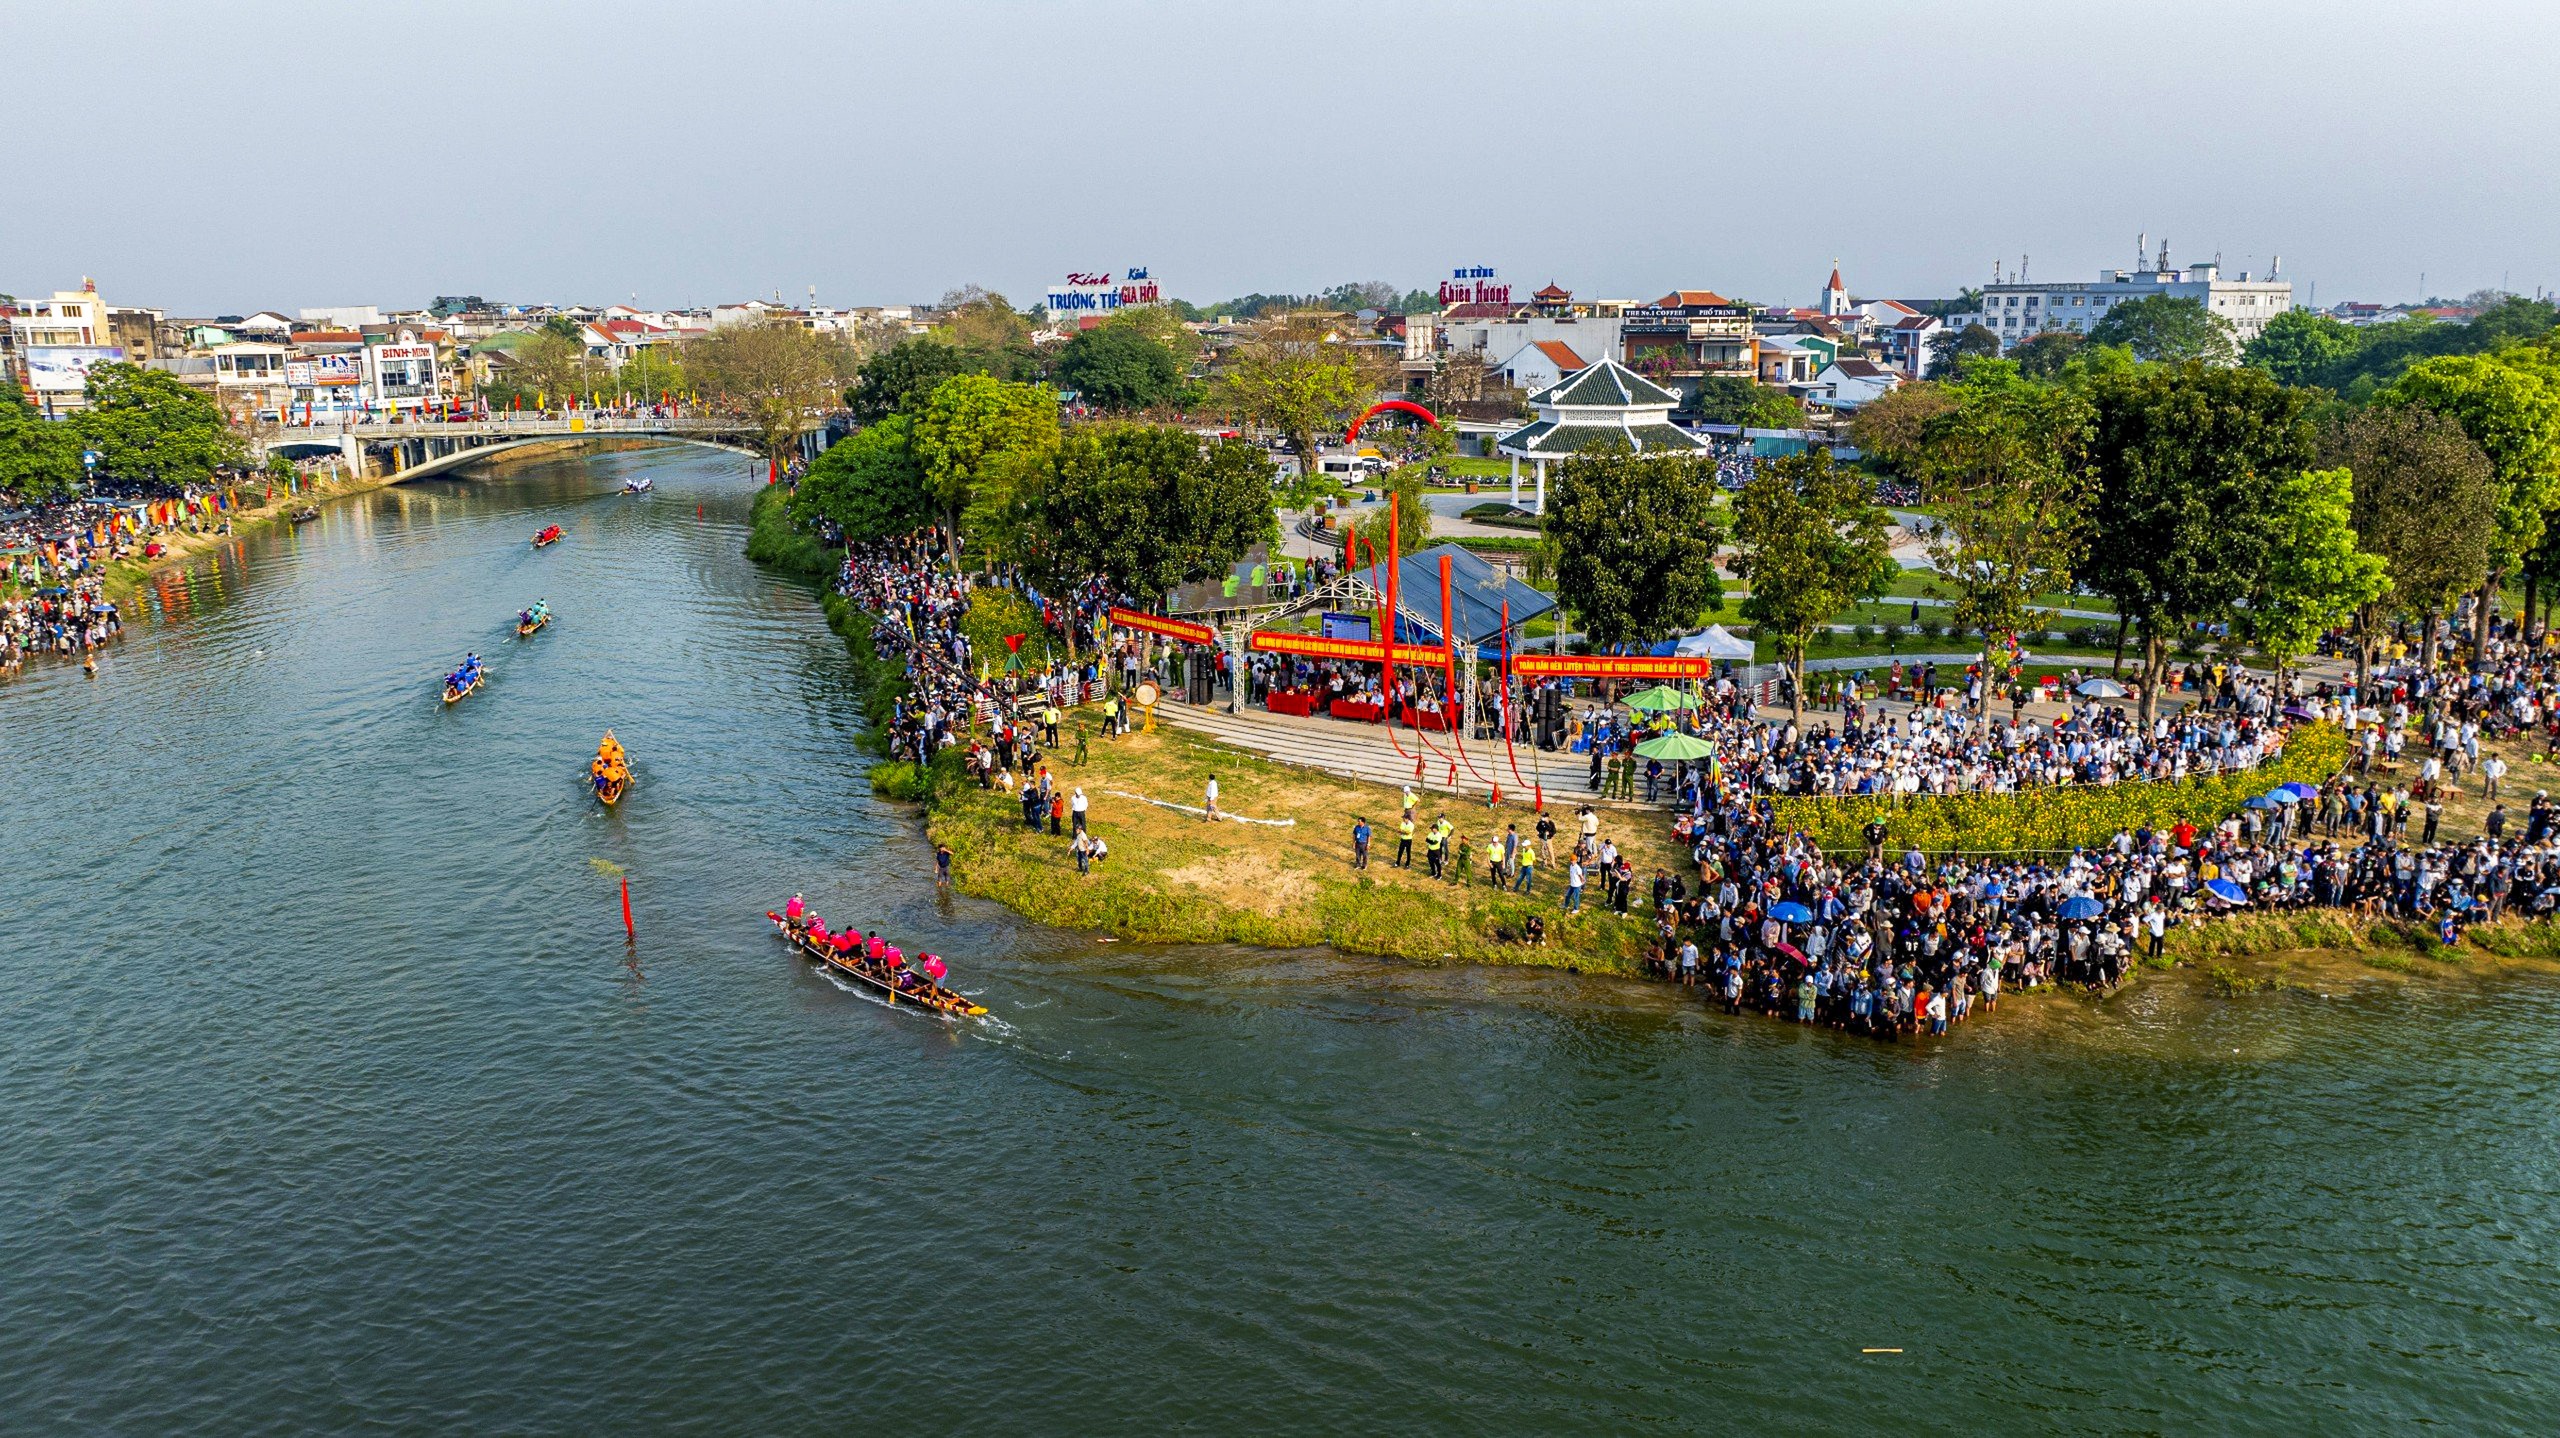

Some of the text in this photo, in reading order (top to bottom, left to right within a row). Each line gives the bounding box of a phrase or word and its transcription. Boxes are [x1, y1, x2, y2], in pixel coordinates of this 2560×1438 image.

[1067, 272, 1110, 285] Kính
[1048, 290, 1096, 310] TRƯỜNG
[1121, 286, 1138, 304] GIA
[1439, 280, 1509, 306] Thiên Hương
[1519, 660, 1535, 670] TOÀN
[1536, 660, 1548, 670] DÂN
[1614, 664, 1629, 672] THEO
[1655, 662, 1667, 672] BÁC
